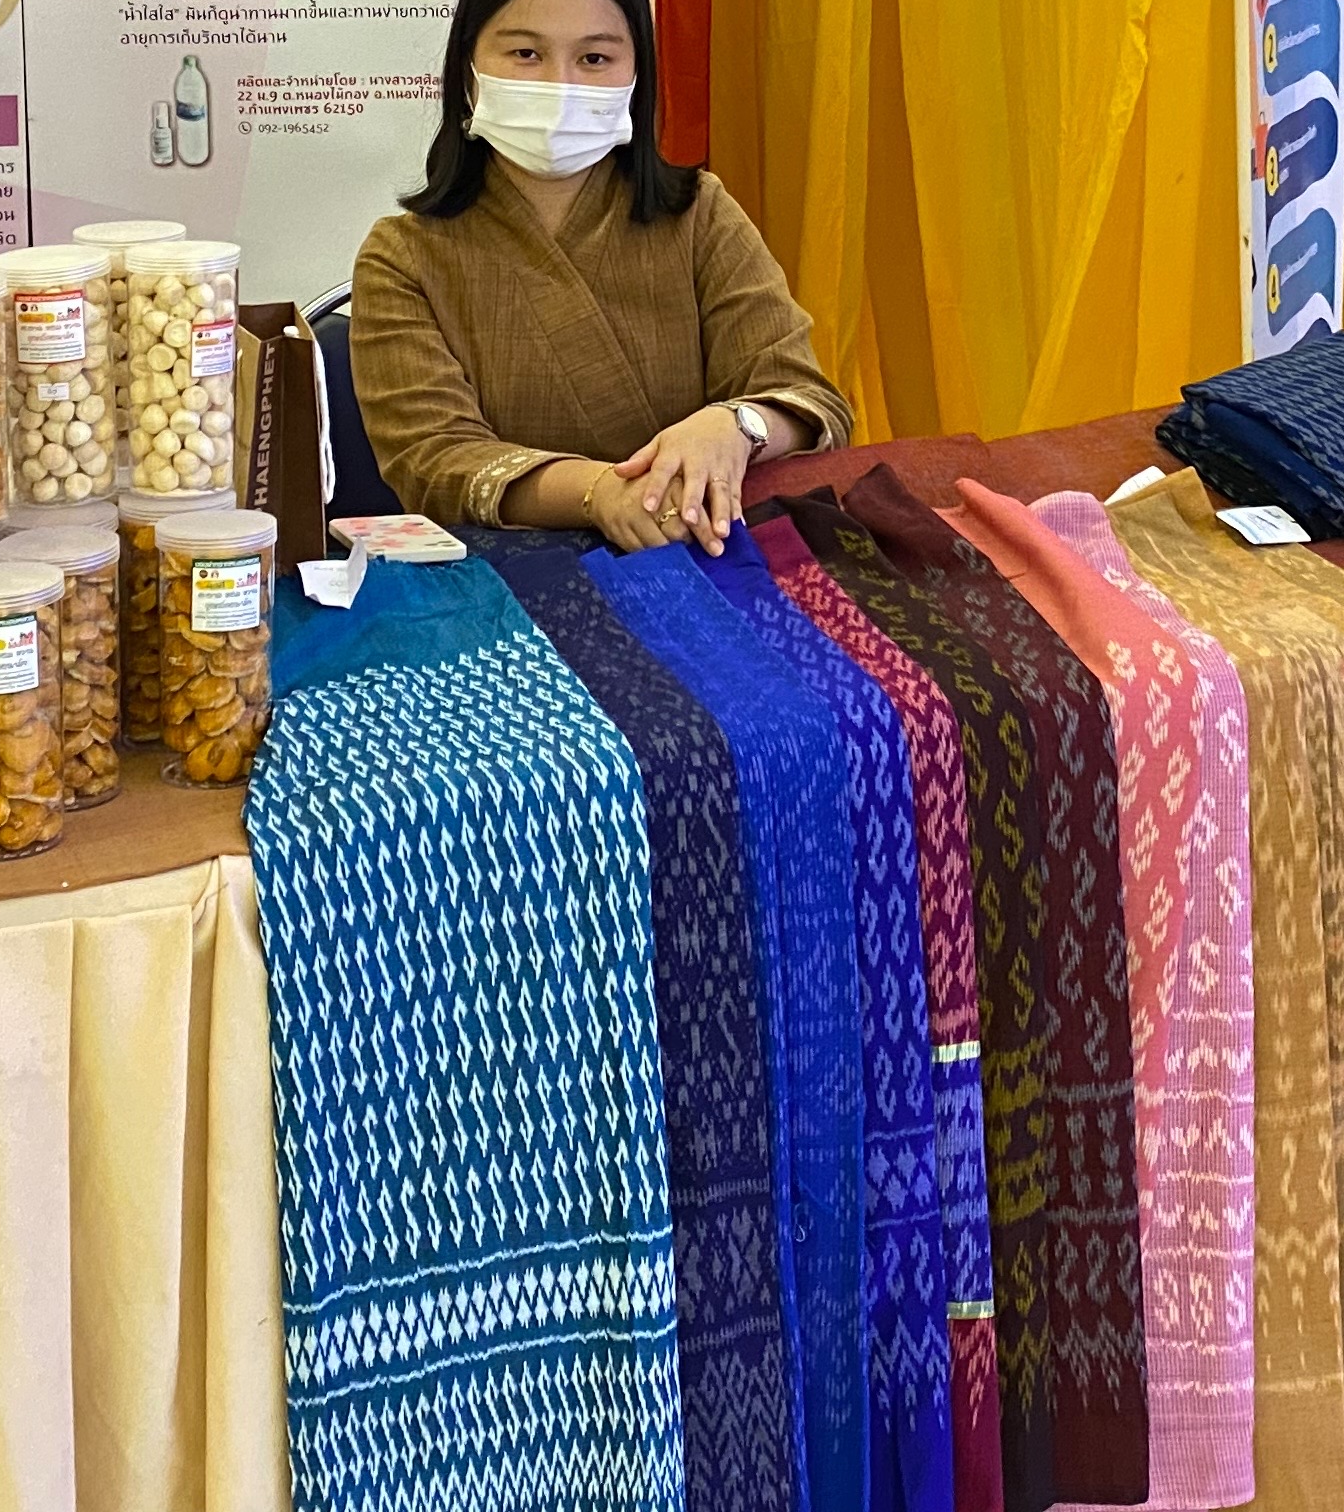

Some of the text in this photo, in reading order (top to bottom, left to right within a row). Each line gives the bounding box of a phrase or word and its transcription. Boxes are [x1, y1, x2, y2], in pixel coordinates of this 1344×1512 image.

[237, 90, 253, 102] 22
[323, 103, 364, 116] 62150
[254, 342, 276, 511] HAENGPHET
